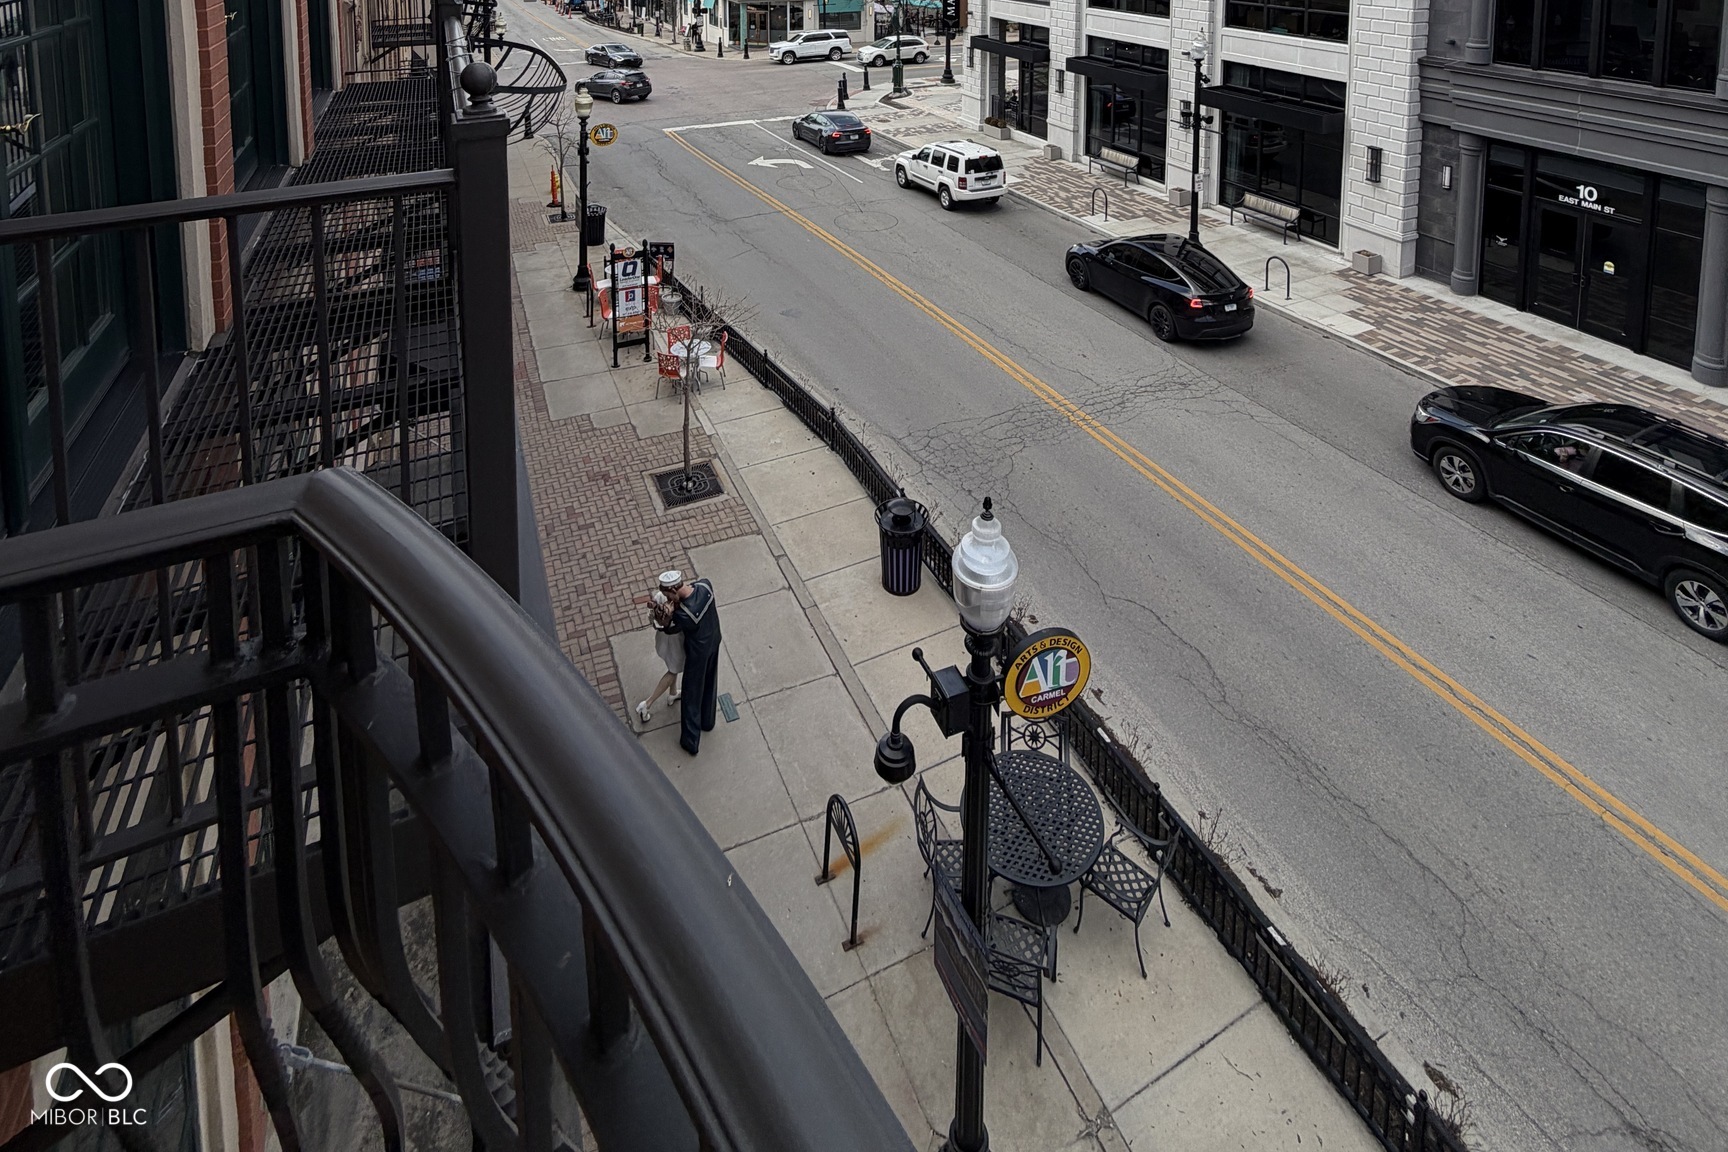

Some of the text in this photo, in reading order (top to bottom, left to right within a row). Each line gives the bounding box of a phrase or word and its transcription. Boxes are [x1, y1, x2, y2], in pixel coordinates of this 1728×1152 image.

[1576, 185, 1598, 202] 10
[1558, 195, 1616, 214] EAST MAIN ST
[1015, 637, 1083, 671] ARTS & DESIGN
[1019, 649, 1079, 699] Art
[1022, 695, 1071, 715] DISTRICT
[1030, 688, 1067, 704] CARMEL
